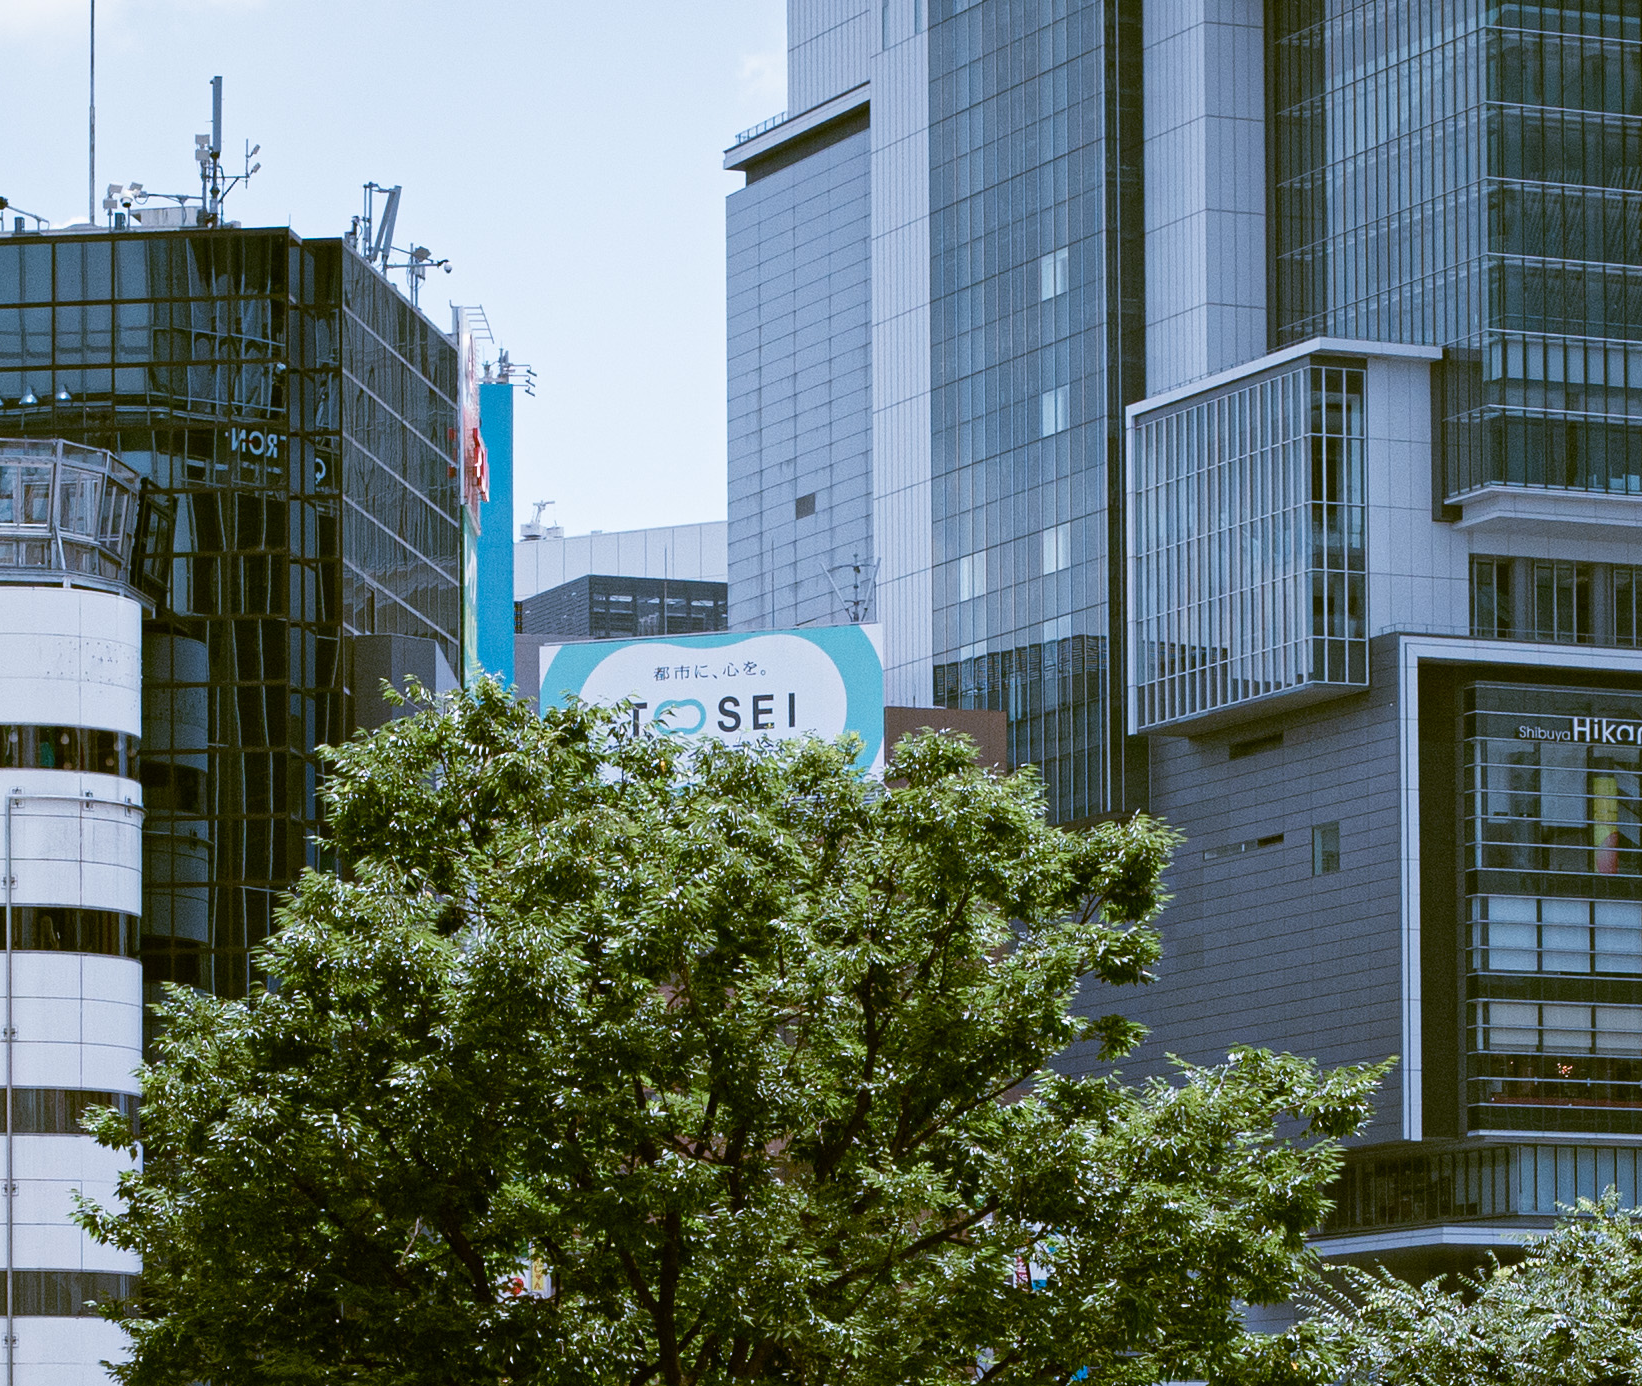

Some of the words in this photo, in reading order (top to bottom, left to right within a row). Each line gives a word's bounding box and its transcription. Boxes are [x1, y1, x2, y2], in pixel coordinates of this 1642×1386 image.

[652, 660, 768, 682] 都市に、心を。
[1519, 726, 1570, 742] Shibuya
